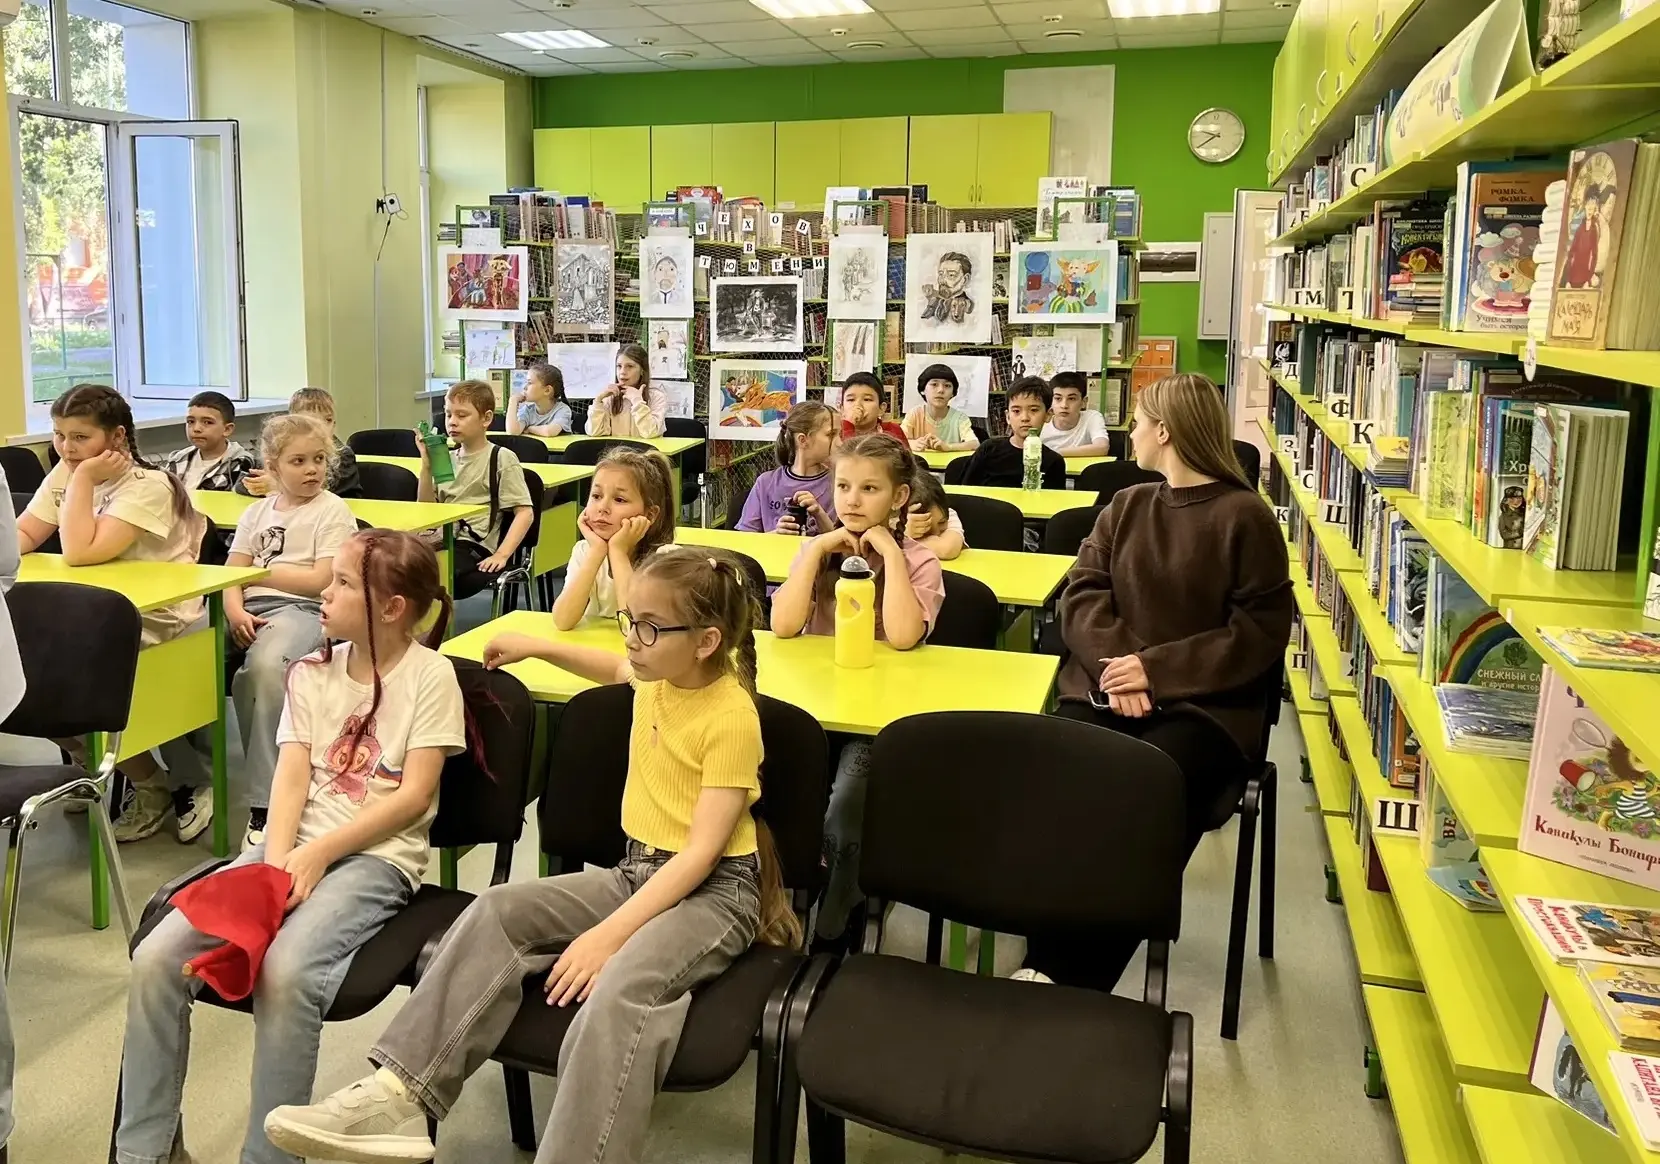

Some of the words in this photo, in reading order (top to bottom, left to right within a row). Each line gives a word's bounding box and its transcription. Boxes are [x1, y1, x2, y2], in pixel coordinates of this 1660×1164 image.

[1351, 168, 1367, 187] С
[1306, 291, 1321, 305] М
[1285, 364, 1298, 379] Д
[1331, 399, 1349, 417] Ф
[1353, 423, 1374, 444] К
[1276, 509, 1288, 521] К
[1477, 669, 1526, 681] СНЕЖНЫЙ
[1377, 800, 1419, 832] Ш
[1535, 815, 1601, 849] Каникулы
[1608, 837, 1660, 871] Бониф
